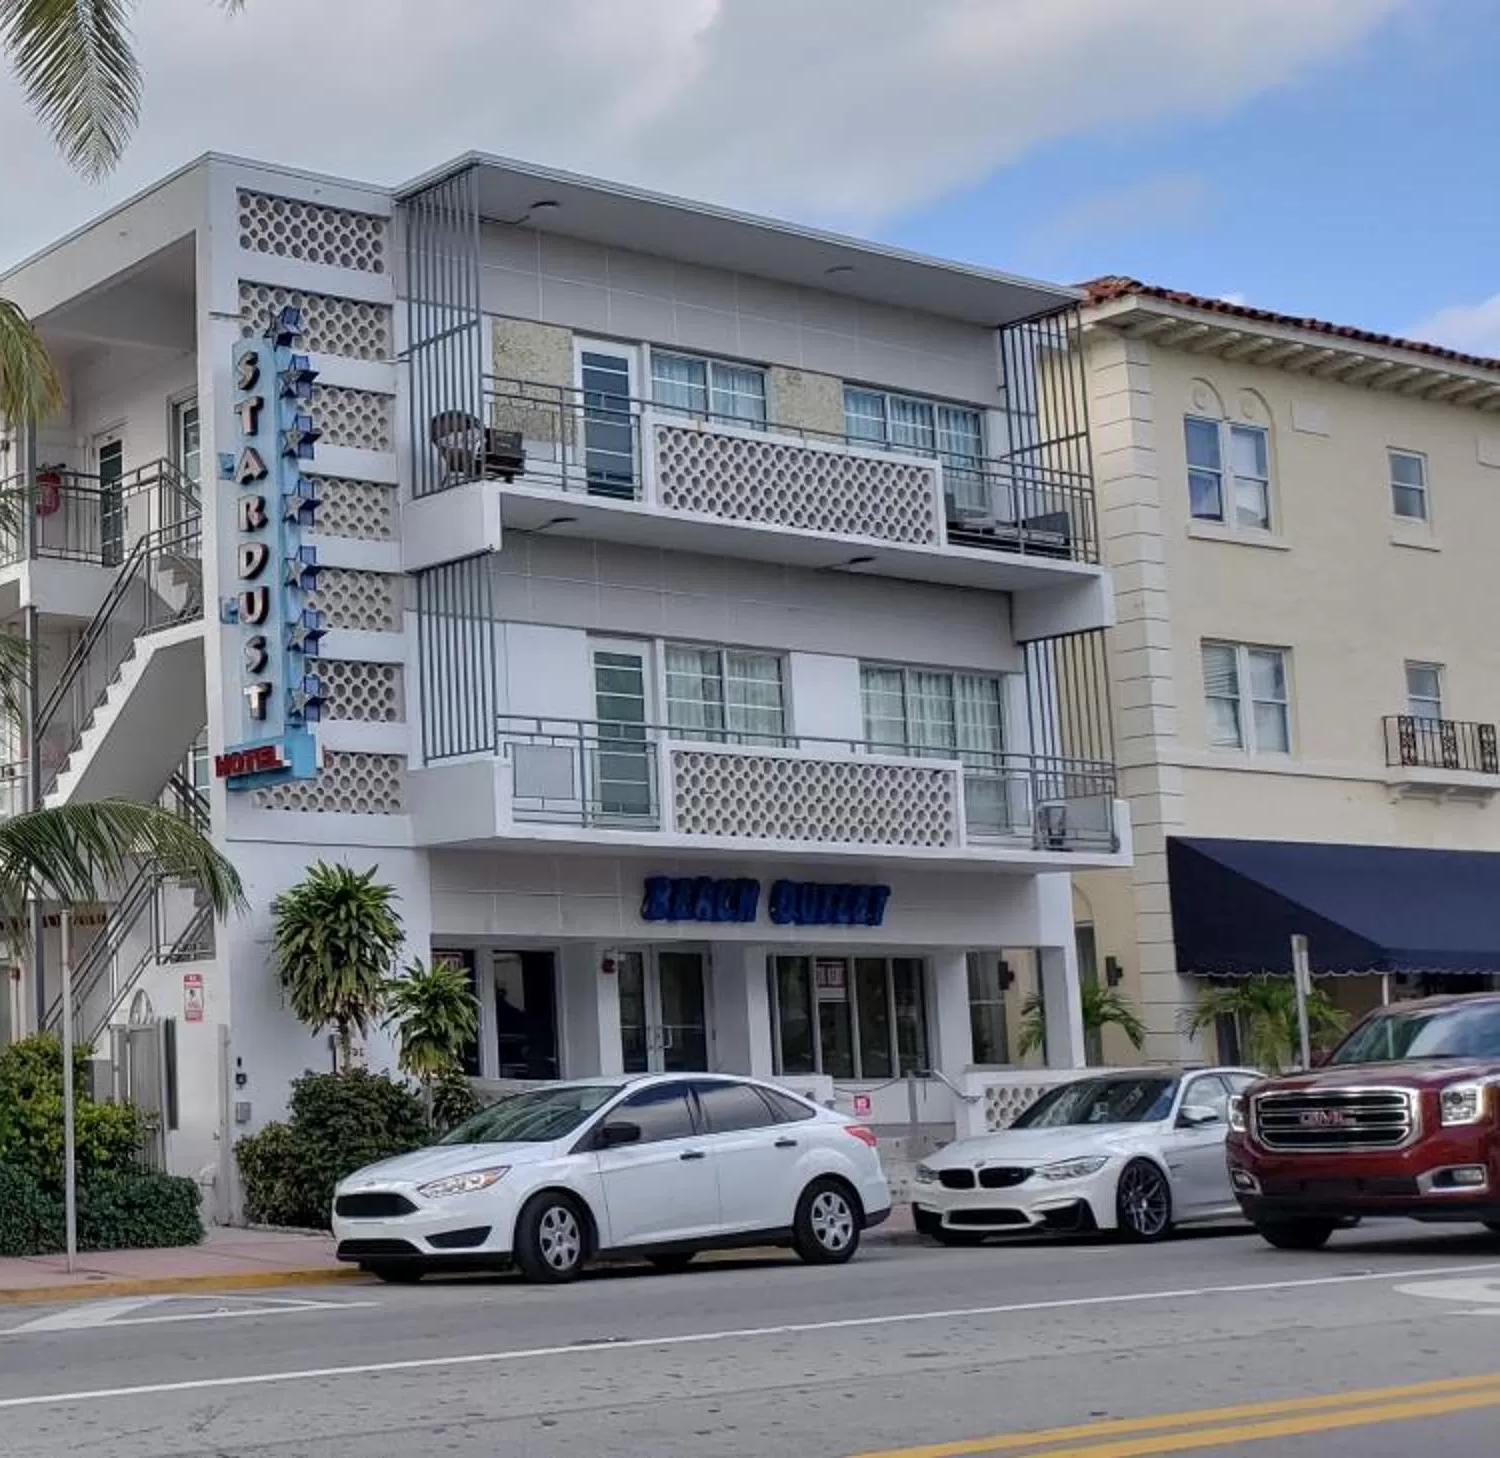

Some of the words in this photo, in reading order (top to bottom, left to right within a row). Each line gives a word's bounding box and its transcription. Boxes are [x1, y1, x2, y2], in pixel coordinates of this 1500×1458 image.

[234, 351, 273, 721] STARDUST
[215, 745, 283, 778] HOTEL
[1299, 1110, 1345, 1126] GMC
